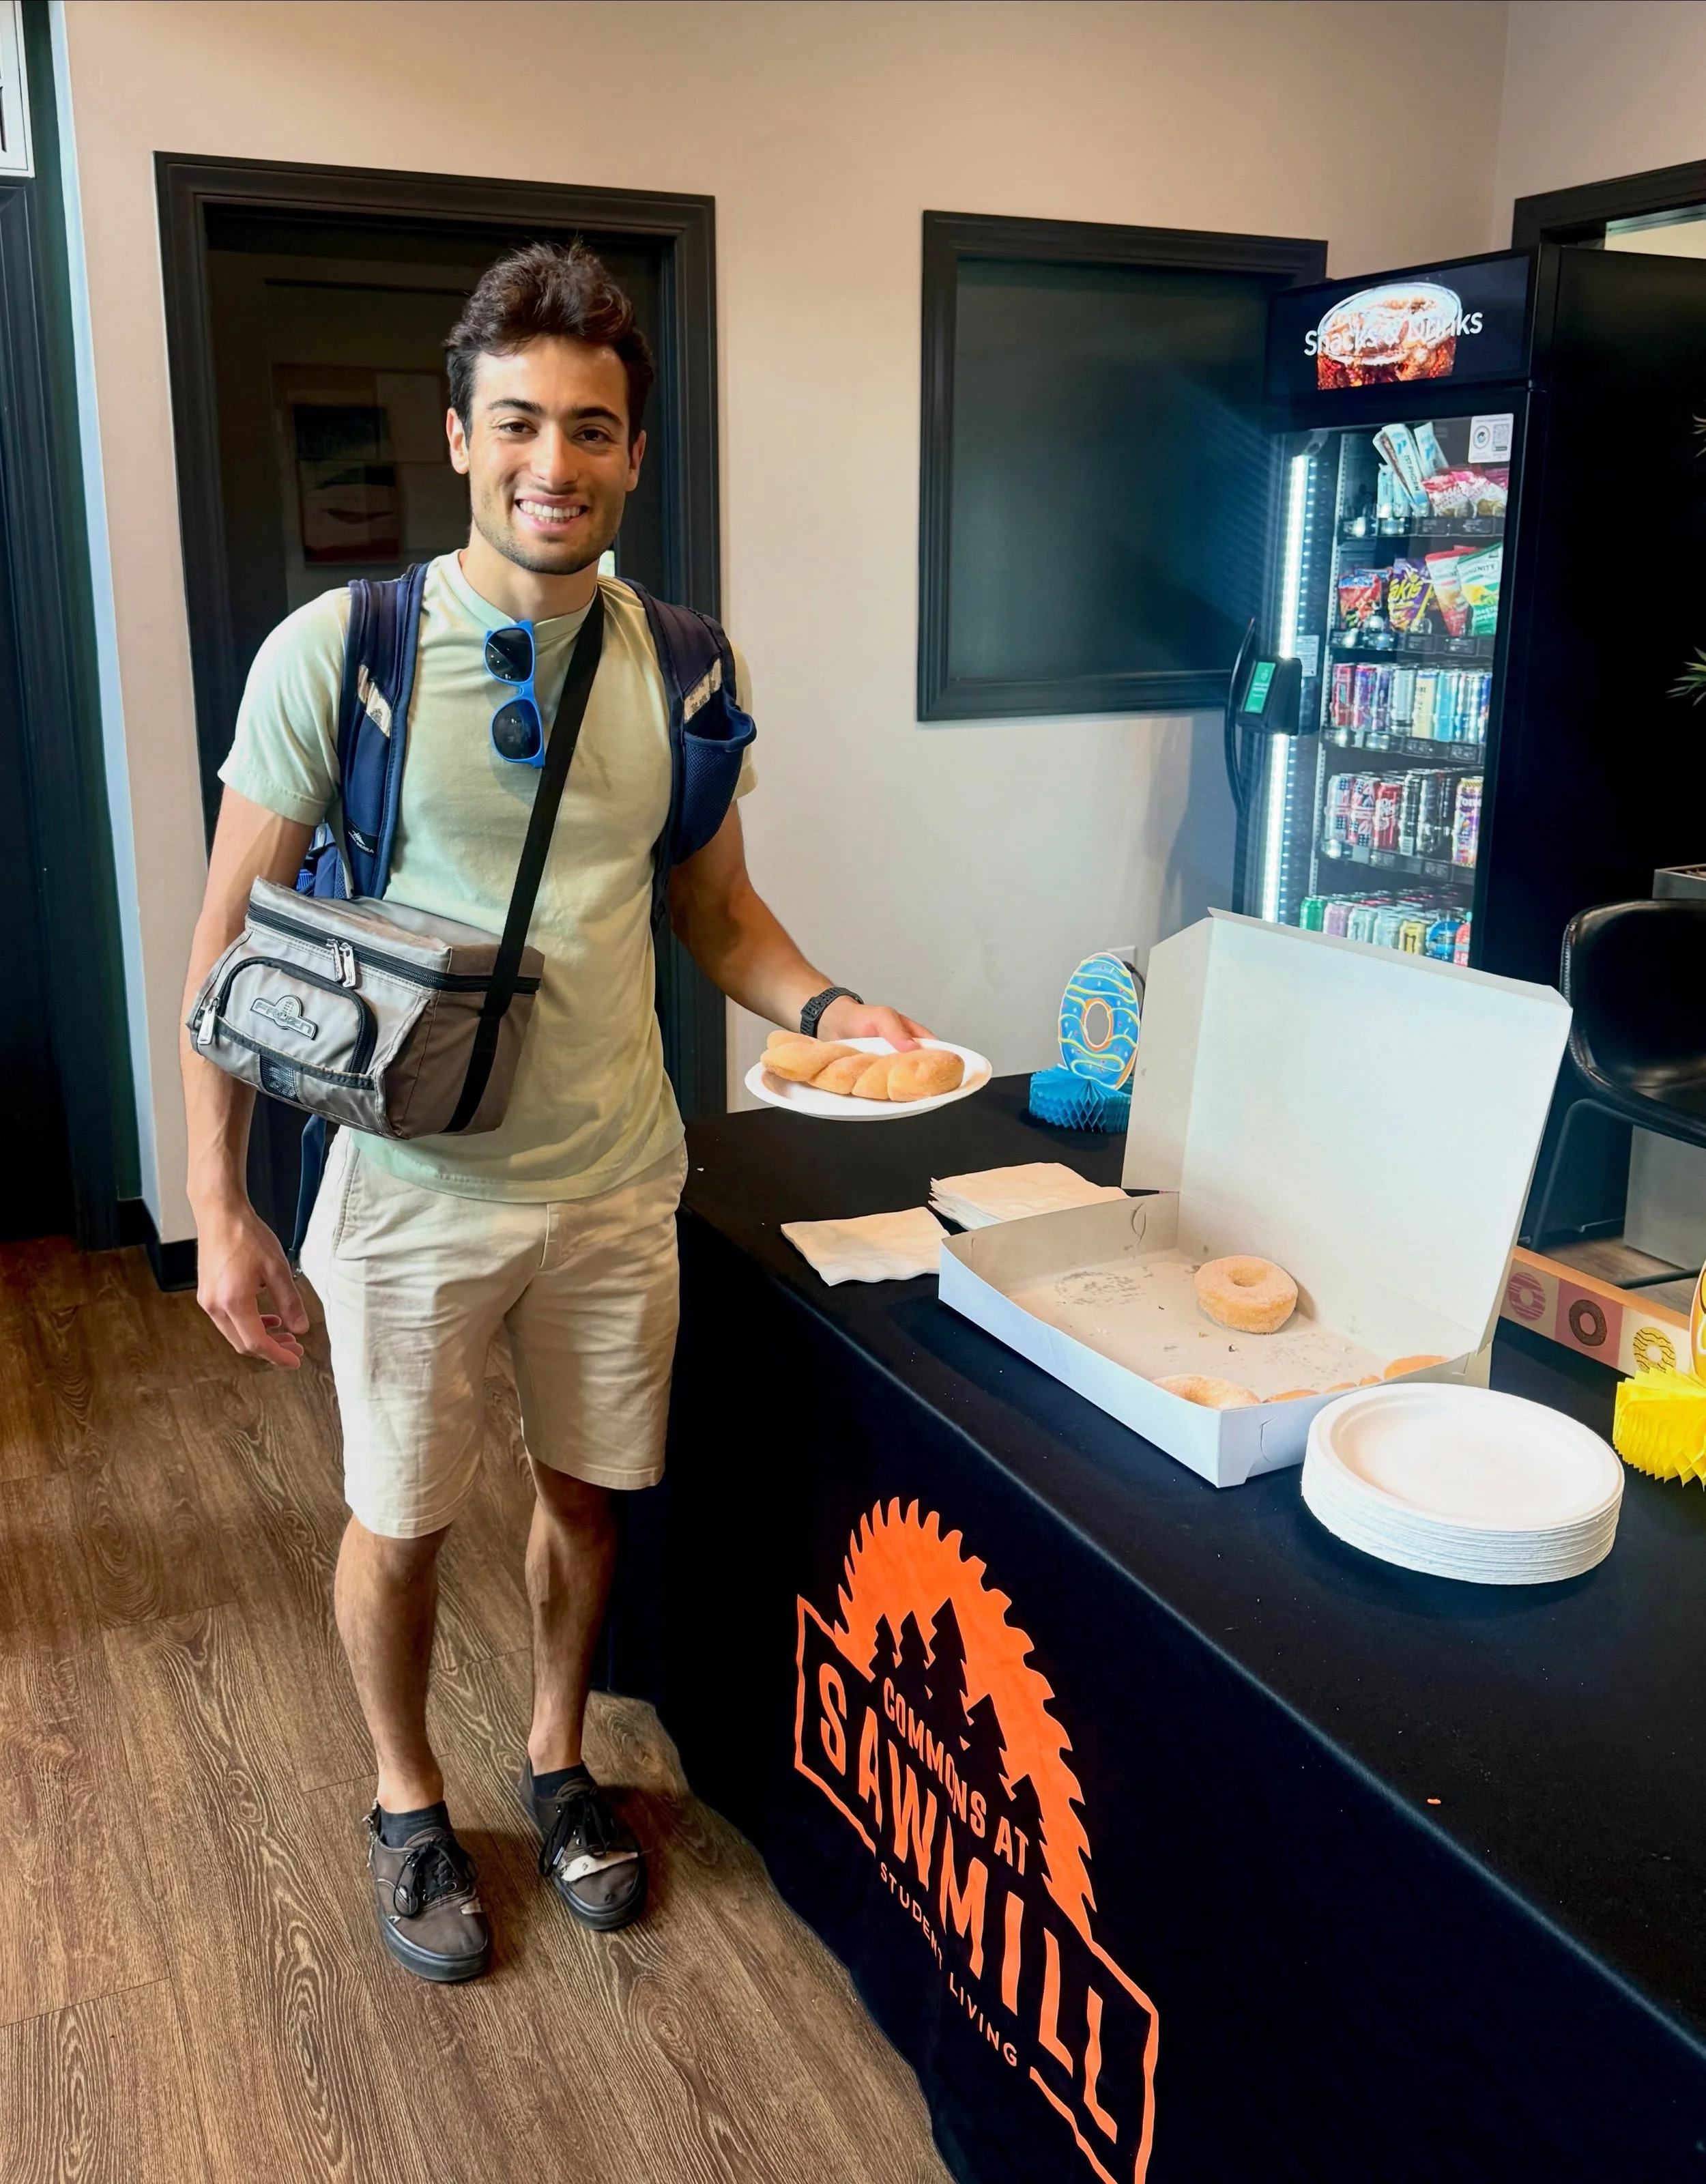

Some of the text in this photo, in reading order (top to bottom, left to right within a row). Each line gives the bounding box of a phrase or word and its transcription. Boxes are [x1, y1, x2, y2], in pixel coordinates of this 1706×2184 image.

[883, 1676, 1030, 1876] COMMONS AT
[818, 1663, 1118, 2144] SAWMILL
[880, 1861, 1017, 2067] STUDENT LIVING
